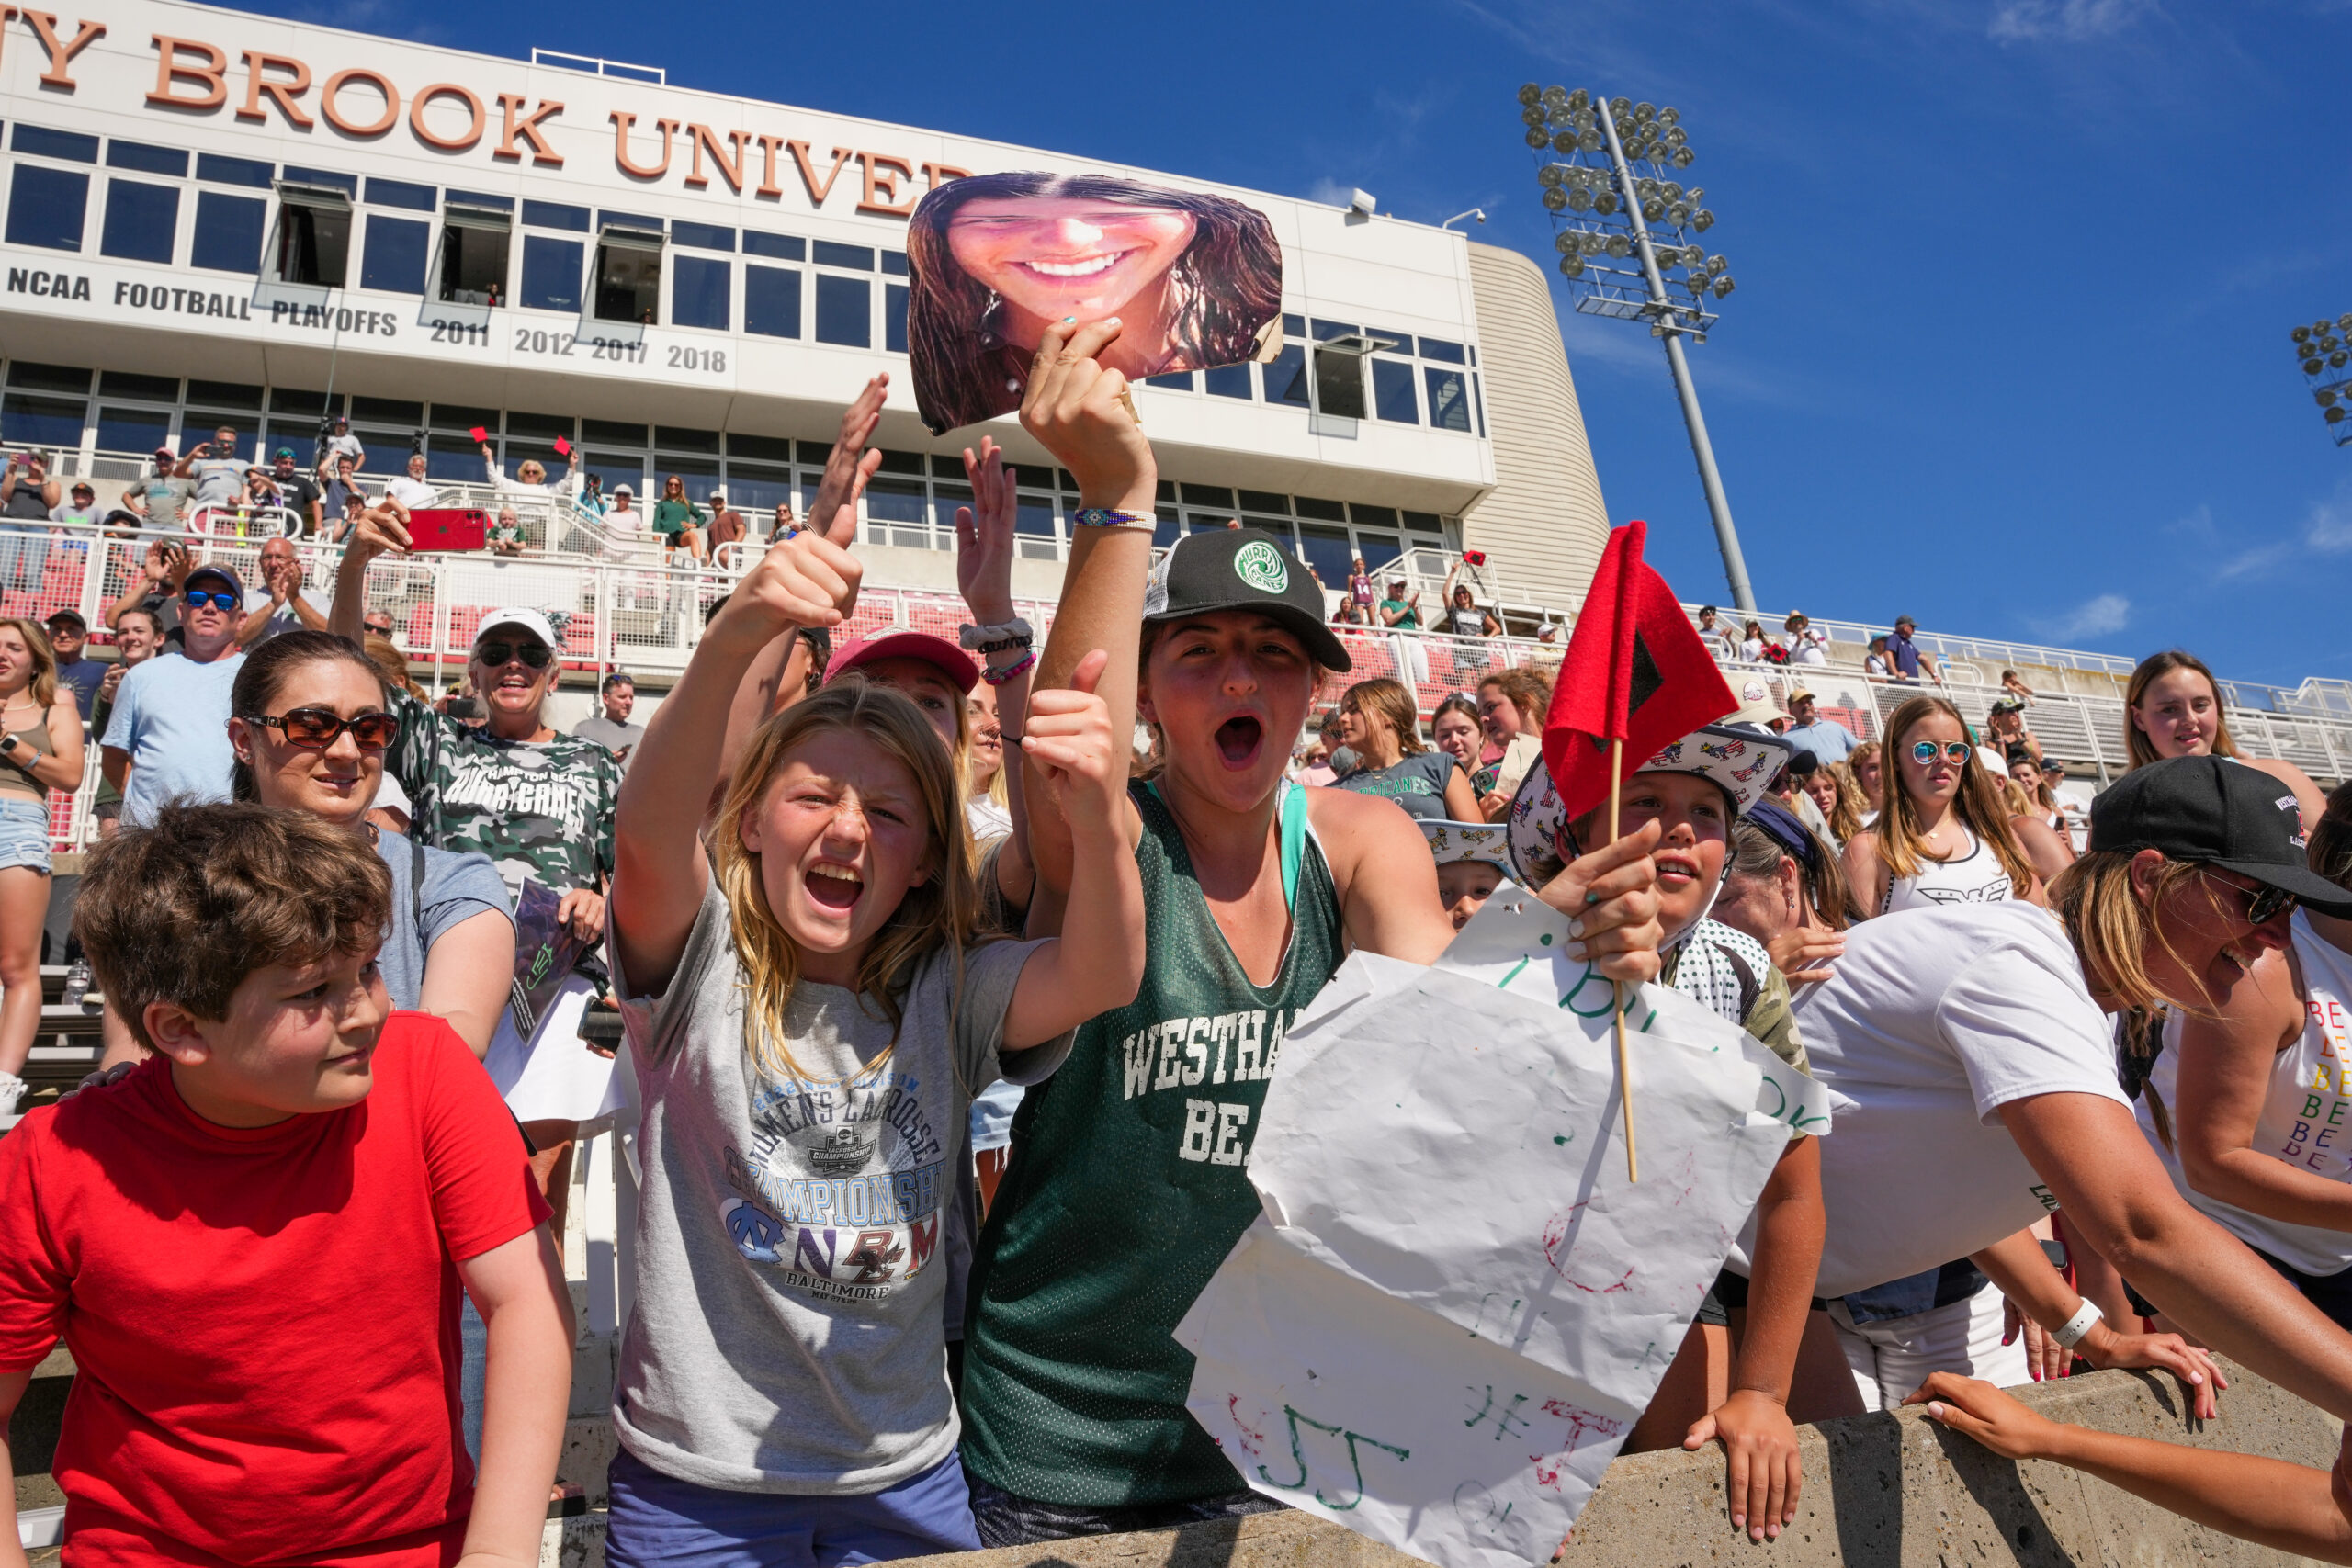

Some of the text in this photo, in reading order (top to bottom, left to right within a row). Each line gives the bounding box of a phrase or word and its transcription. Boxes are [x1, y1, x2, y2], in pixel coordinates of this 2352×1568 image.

[0, 2, 107, 90] Y
[145, 33, 565, 165] BROOK
[7, 266, 727, 374] NCAA FOOTBALL PLAYOFFS 2011 2012 2017 2018
[1356, 584, 1371, 595] 14
[550, 771, 585, 786] BEAC
[2307, 1001, 2345, 1029] BE
[1123, 1009, 1305, 1100] WESTHA
[2312, 1062, 2352, 1097] BE
[754, 1081, 797, 1111] 2022
[2300, 1093, 2349, 1125] BE
[842, 1088, 941, 1165] LACROSSE
[1179, 1099, 1250, 1167] BE
[2290, 1120, 2338, 1148] BE
[812, 1145, 872, 1160] CHAMPIONSHIP
[828, 1145, 858, 1154] LACROSSE
[786, 1271, 890, 1300] BALTIMORE
[811, 1290, 829, 1301] MAY
